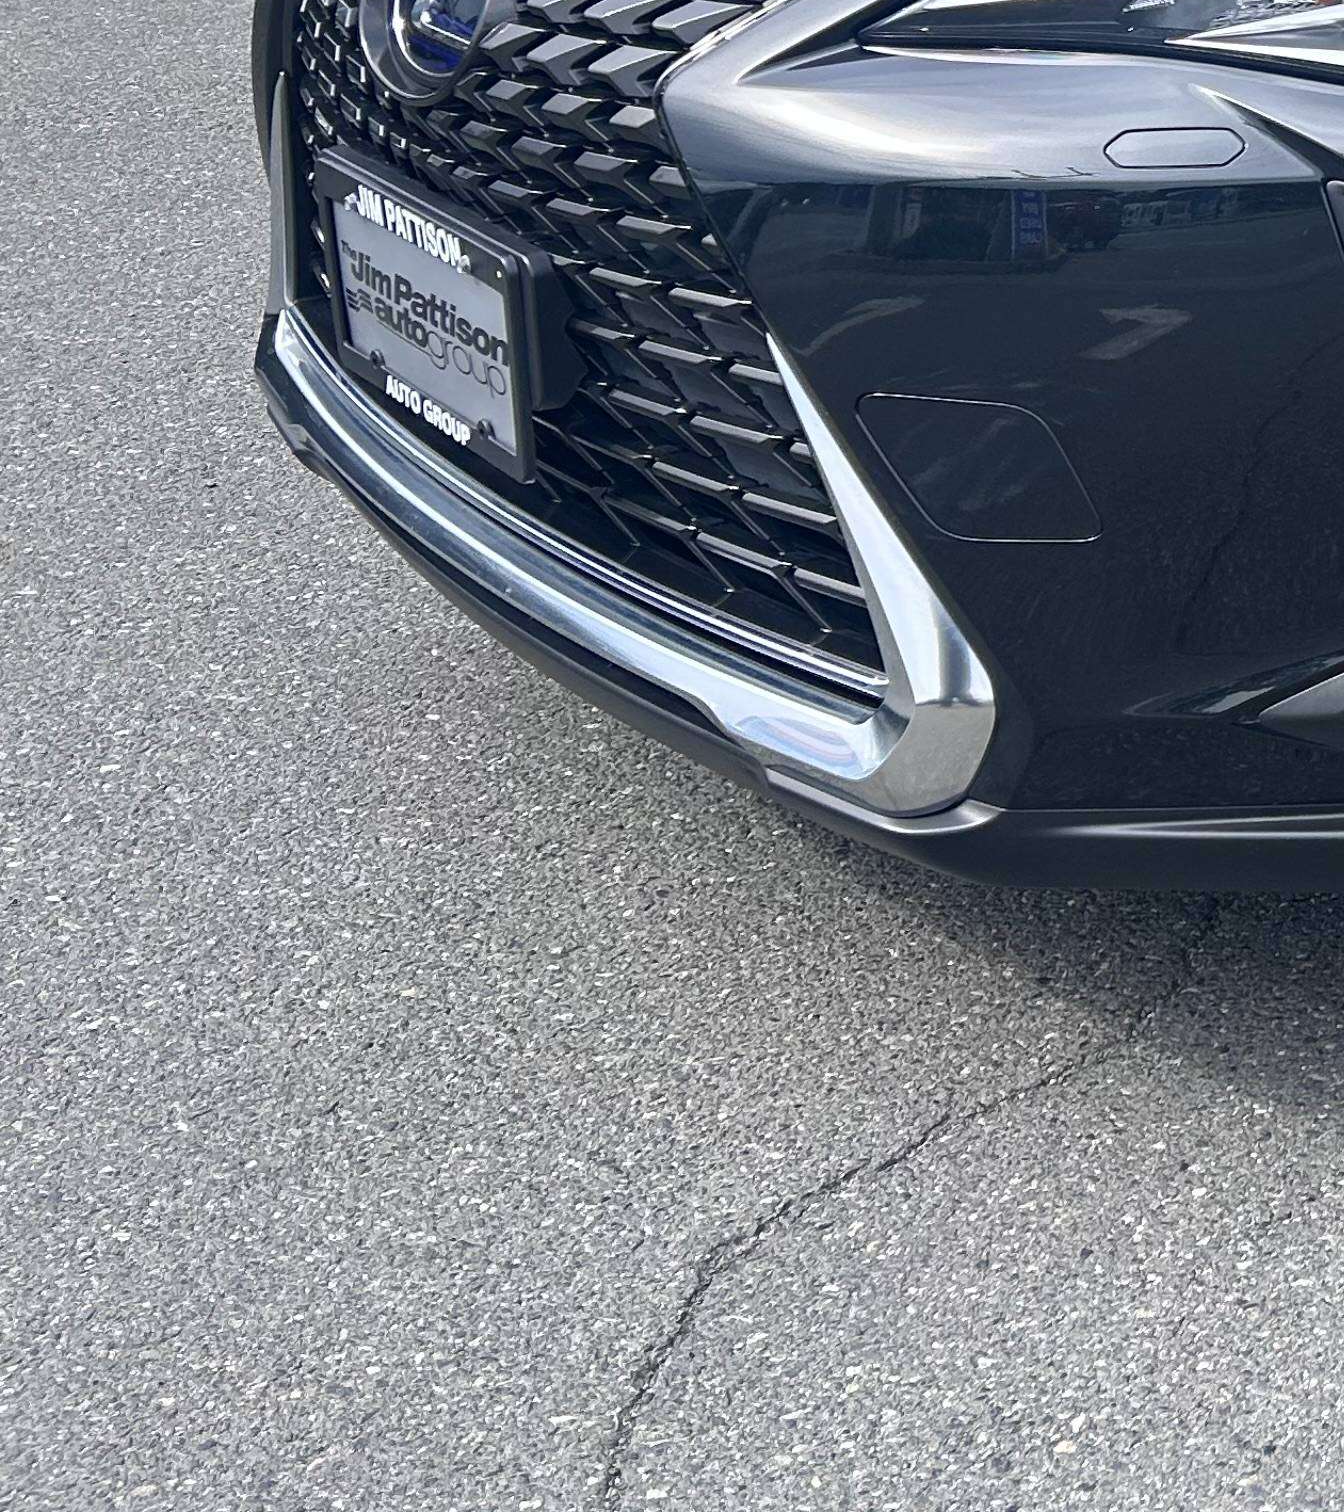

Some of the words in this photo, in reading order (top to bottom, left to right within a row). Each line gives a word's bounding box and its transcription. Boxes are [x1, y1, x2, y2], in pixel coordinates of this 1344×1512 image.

[356, 184, 385, 227] JIM
[385, 201, 461, 267] PATTISON
[385, 375, 421, 415] AUTO
[422, 401, 472, 446] GROUP
